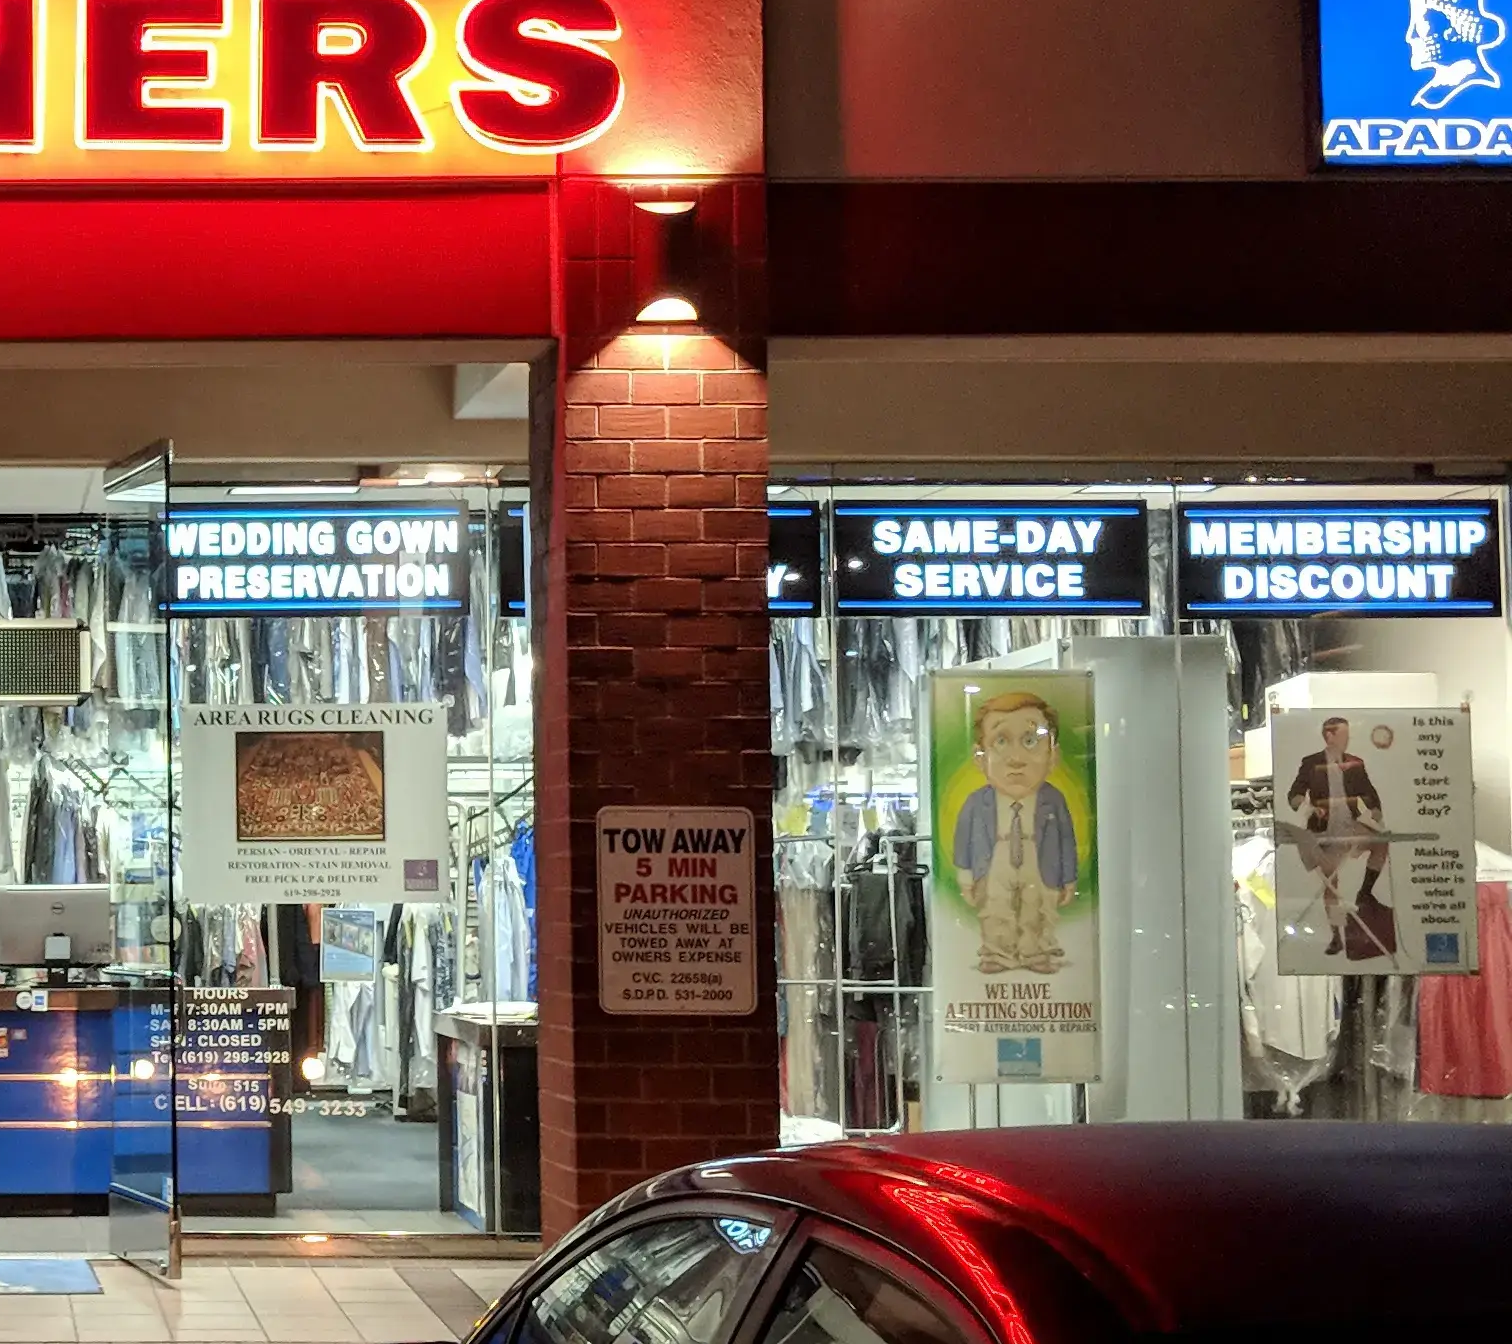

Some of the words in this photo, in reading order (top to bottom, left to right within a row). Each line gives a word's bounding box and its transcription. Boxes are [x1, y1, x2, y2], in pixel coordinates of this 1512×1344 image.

[161, 521, 335, 557] WEDDING
[346, 520, 458, 555] GOWN
[872, 519, 1102, 555] SAME-DAY
[1189, 520, 1487, 556] MEMBERSHIP
[176, 563, 449, 599] PRESERVATION
[893, 562, 1084, 599] SERVICE
[1224, 563, 1454, 600] DISCOUNT
[193, 709, 251, 727] AREA
[258, 709, 314, 726] RUGS
[320, 708, 433, 726] CLEANING
[1413, 717, 1425, 726] Is
[1428, 716, 1454, 726] this
[1418, 733, 1442, 744] any
[1416, 748, 1444, 758] way
[1424, 762, 1439, 771] to
[1413, 777, 1450, 786] start
[1416, 793, 1448, 804] your
[1418, 806, 1451, 816] day?
[603, 828, 666, 854] TOW
[671, 828, 747, 854] AWAY
[237, 847, 281, 856] PERSIAN
[289, 847, 342, 856] ORIENTAL
[349, 847, 387, 856] REPAIR
[1414, 848, 1460, 859] Making
[228, 860, 300, 870] RESTORATION
[308, 860, 339, 869] STAIN
[340, 860, 392, 870] REMOVAL
[635, 858, 652, 877] 5
[668, 858, 717, 878] MIN
[1410, 862, 1439, 873] your
[1441, 861, 1464, 871] life
[245, 874, 272, 884] FREE
[274, 874, 299, 884] PICK
[301, 874, 316, 884] UP
[317, 874, 325, 884] &
[327, 874, 380, 884] DELIVERY
[1411, 875, 1451, 884] easier
[1454, 875, 1465, 884] is
[614, 883, 738, 904] PARKING
[1424, 887, 1455, 898] what
[622, 909, 730, 920] UNAUTHORIZED
[604, 923, 677, 934] VEHICLES
[686, 923, 722, 934] WILL
[730, 923, 750, 934] BE
[619, 937, 668, 949] TOWED
[675, 937, 710, 949] AWAY
[718, 937, 736, 949] AT
[612, 951, 672, 963] OWNERS
[678, 951, 742, 963] EXPENSE
[670, 972, 723, 986] 22658(a)
[193, 988, 249, 1000] HOURS
[675, 989, 733, 1001] 531-2000
[984, 983, 1009, 1000] WE
[1011, 983, 1051, 1000] HAVE
[187, 1003, 243, 1016] 7:30AM
[255, 1003, 288, 1016] 7PM
[945, 1003, 956, 1019] A
[957, 1002, 1017, 1019] FITTING
[1020, 1002, 1093, 1019] SOLUTION
[187, 1018, 244, 1031] 8:30AM
[257, 1018, 290, 1031] 5PM
[984, 1022, 1046, 1034] ALTERATIONS
[1050, 1023, 1056, 1033] &
[1059, 1022, 1098, 1033] REPAIRS
[197, 1034, 262, 1048] CLOSED
[151, 1051, 218, 1065] Te.(619)
[223, 1051, 290, 1064] 298-2928
[233, 1080, 260, 1093] 515
[220, 1095, 266, 1114] (619)
